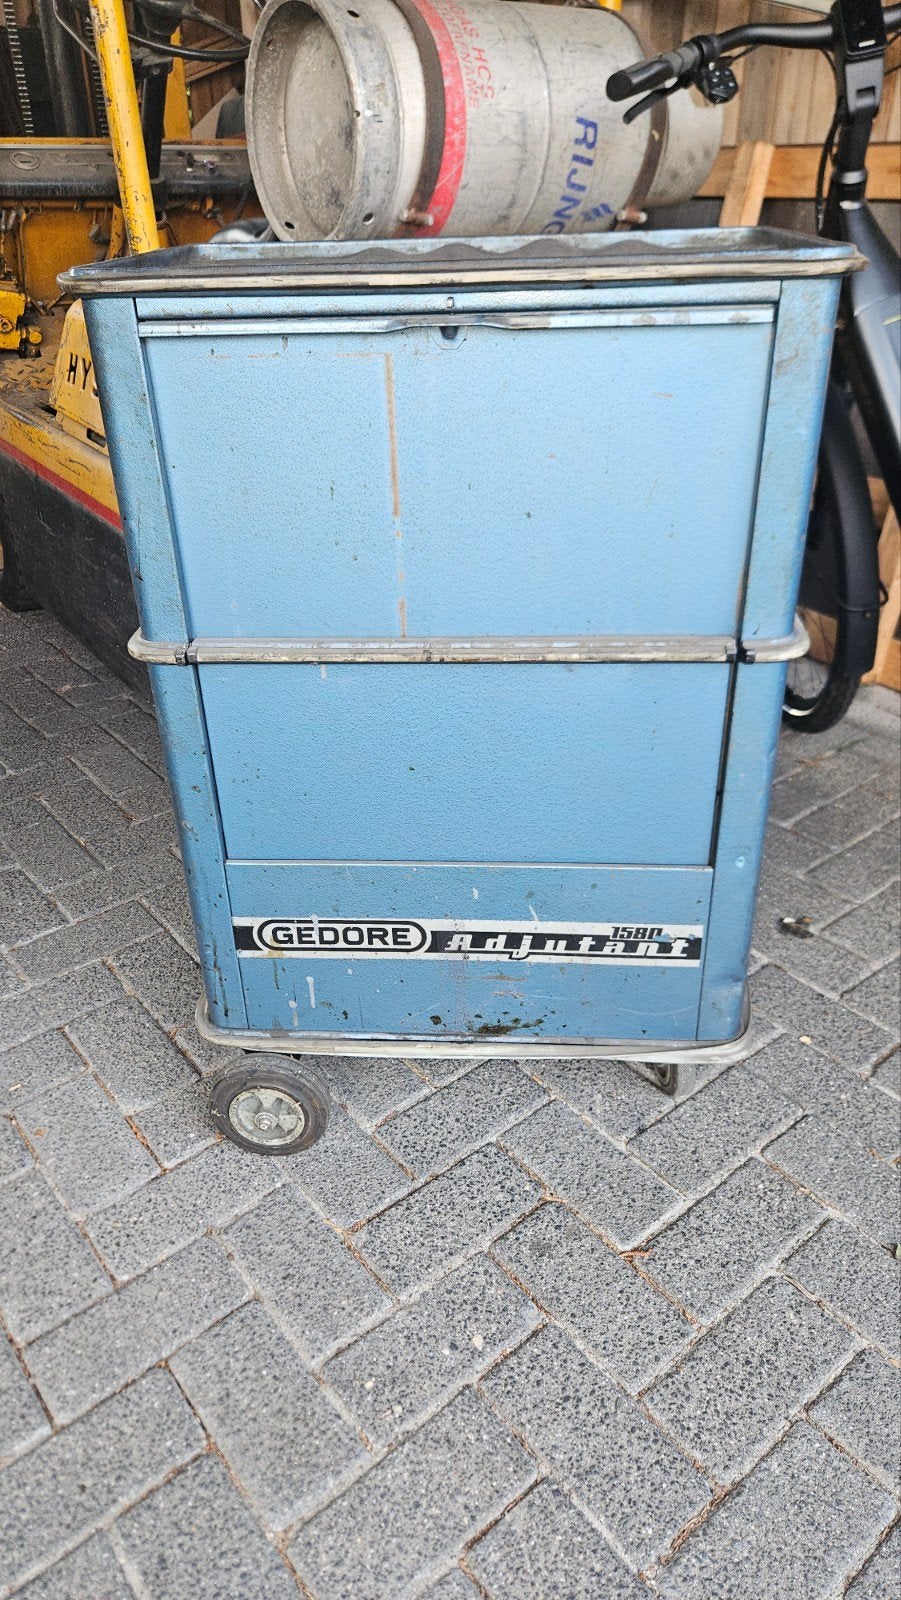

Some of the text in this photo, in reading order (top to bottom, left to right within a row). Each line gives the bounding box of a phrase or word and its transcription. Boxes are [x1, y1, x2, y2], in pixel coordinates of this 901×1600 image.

[471, 46, 496, 99] HCS
[67, 352, 99, 398] HY
[271, 926, 412, 946] GEDORE
[444, 933, 690, 959] Adjutant
